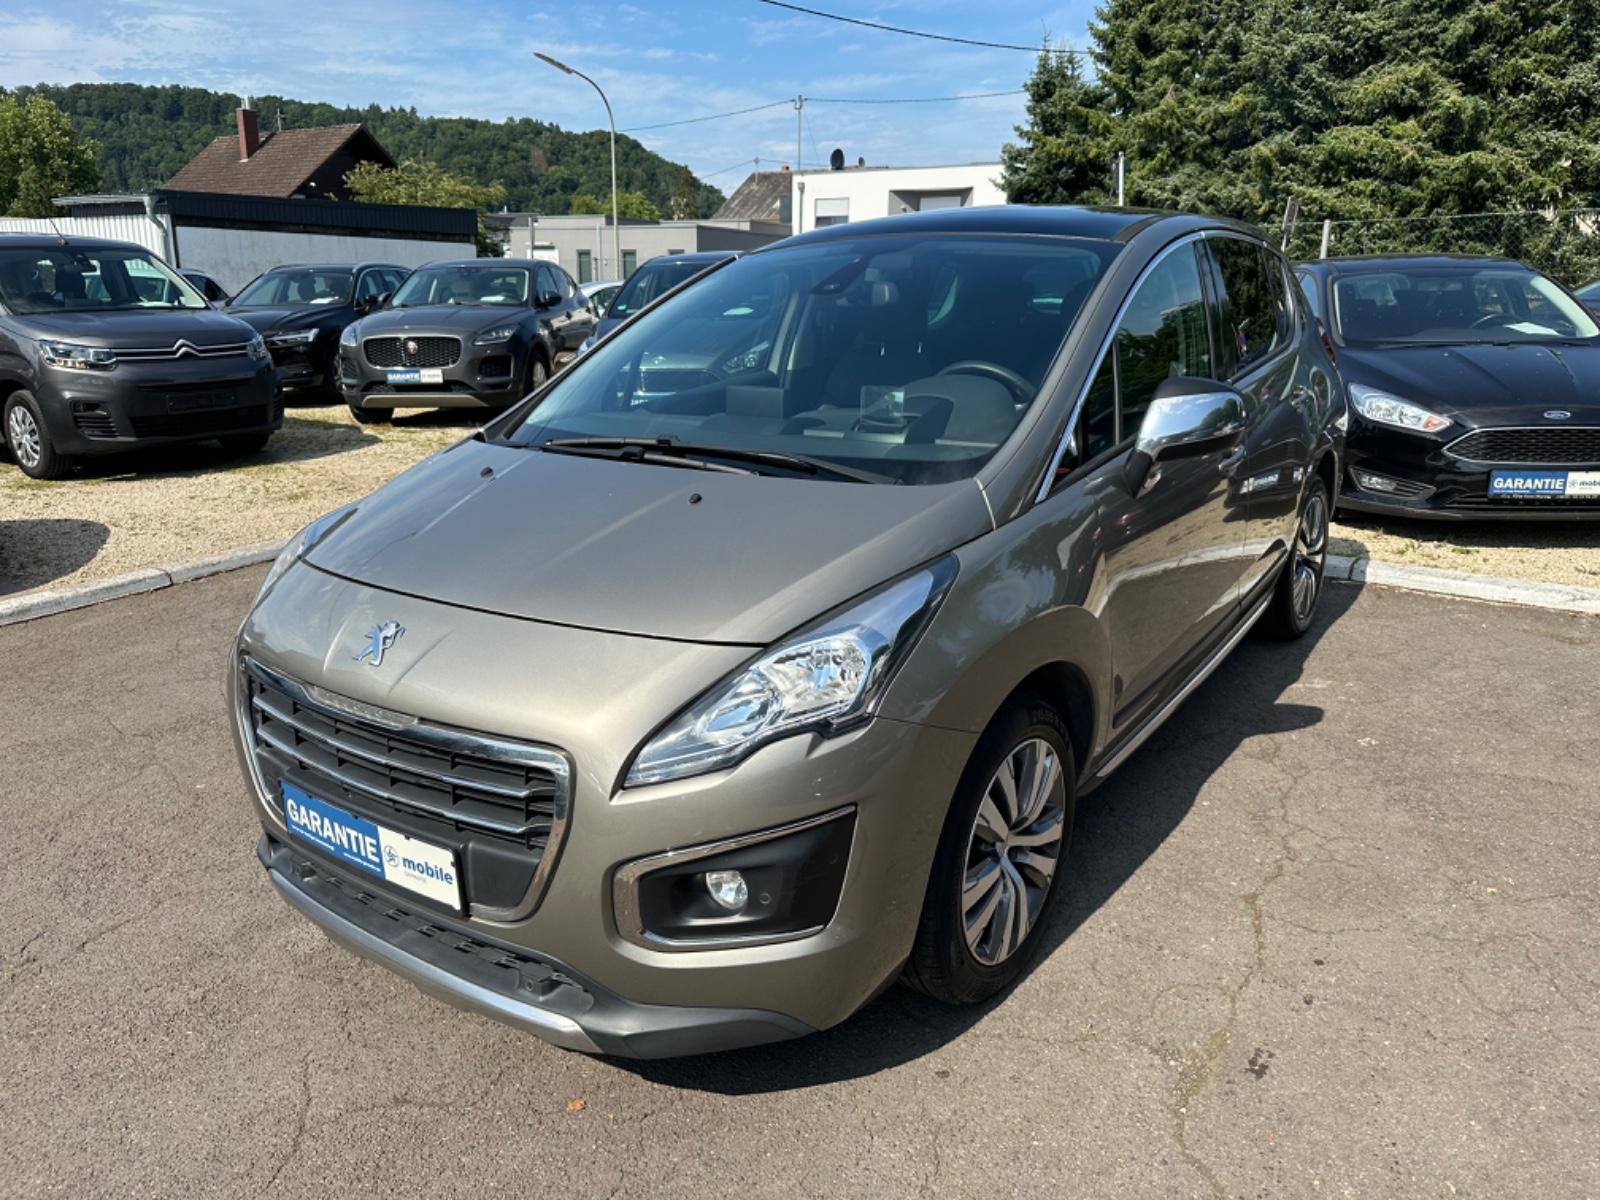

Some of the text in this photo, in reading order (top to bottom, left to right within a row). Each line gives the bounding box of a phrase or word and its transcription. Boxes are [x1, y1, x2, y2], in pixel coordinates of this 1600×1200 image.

[1494, 478, 1565, 489] GARANTIE
[287, 799, 380, 863] GARANTIE
[402, 856, 453, 885] mobile
